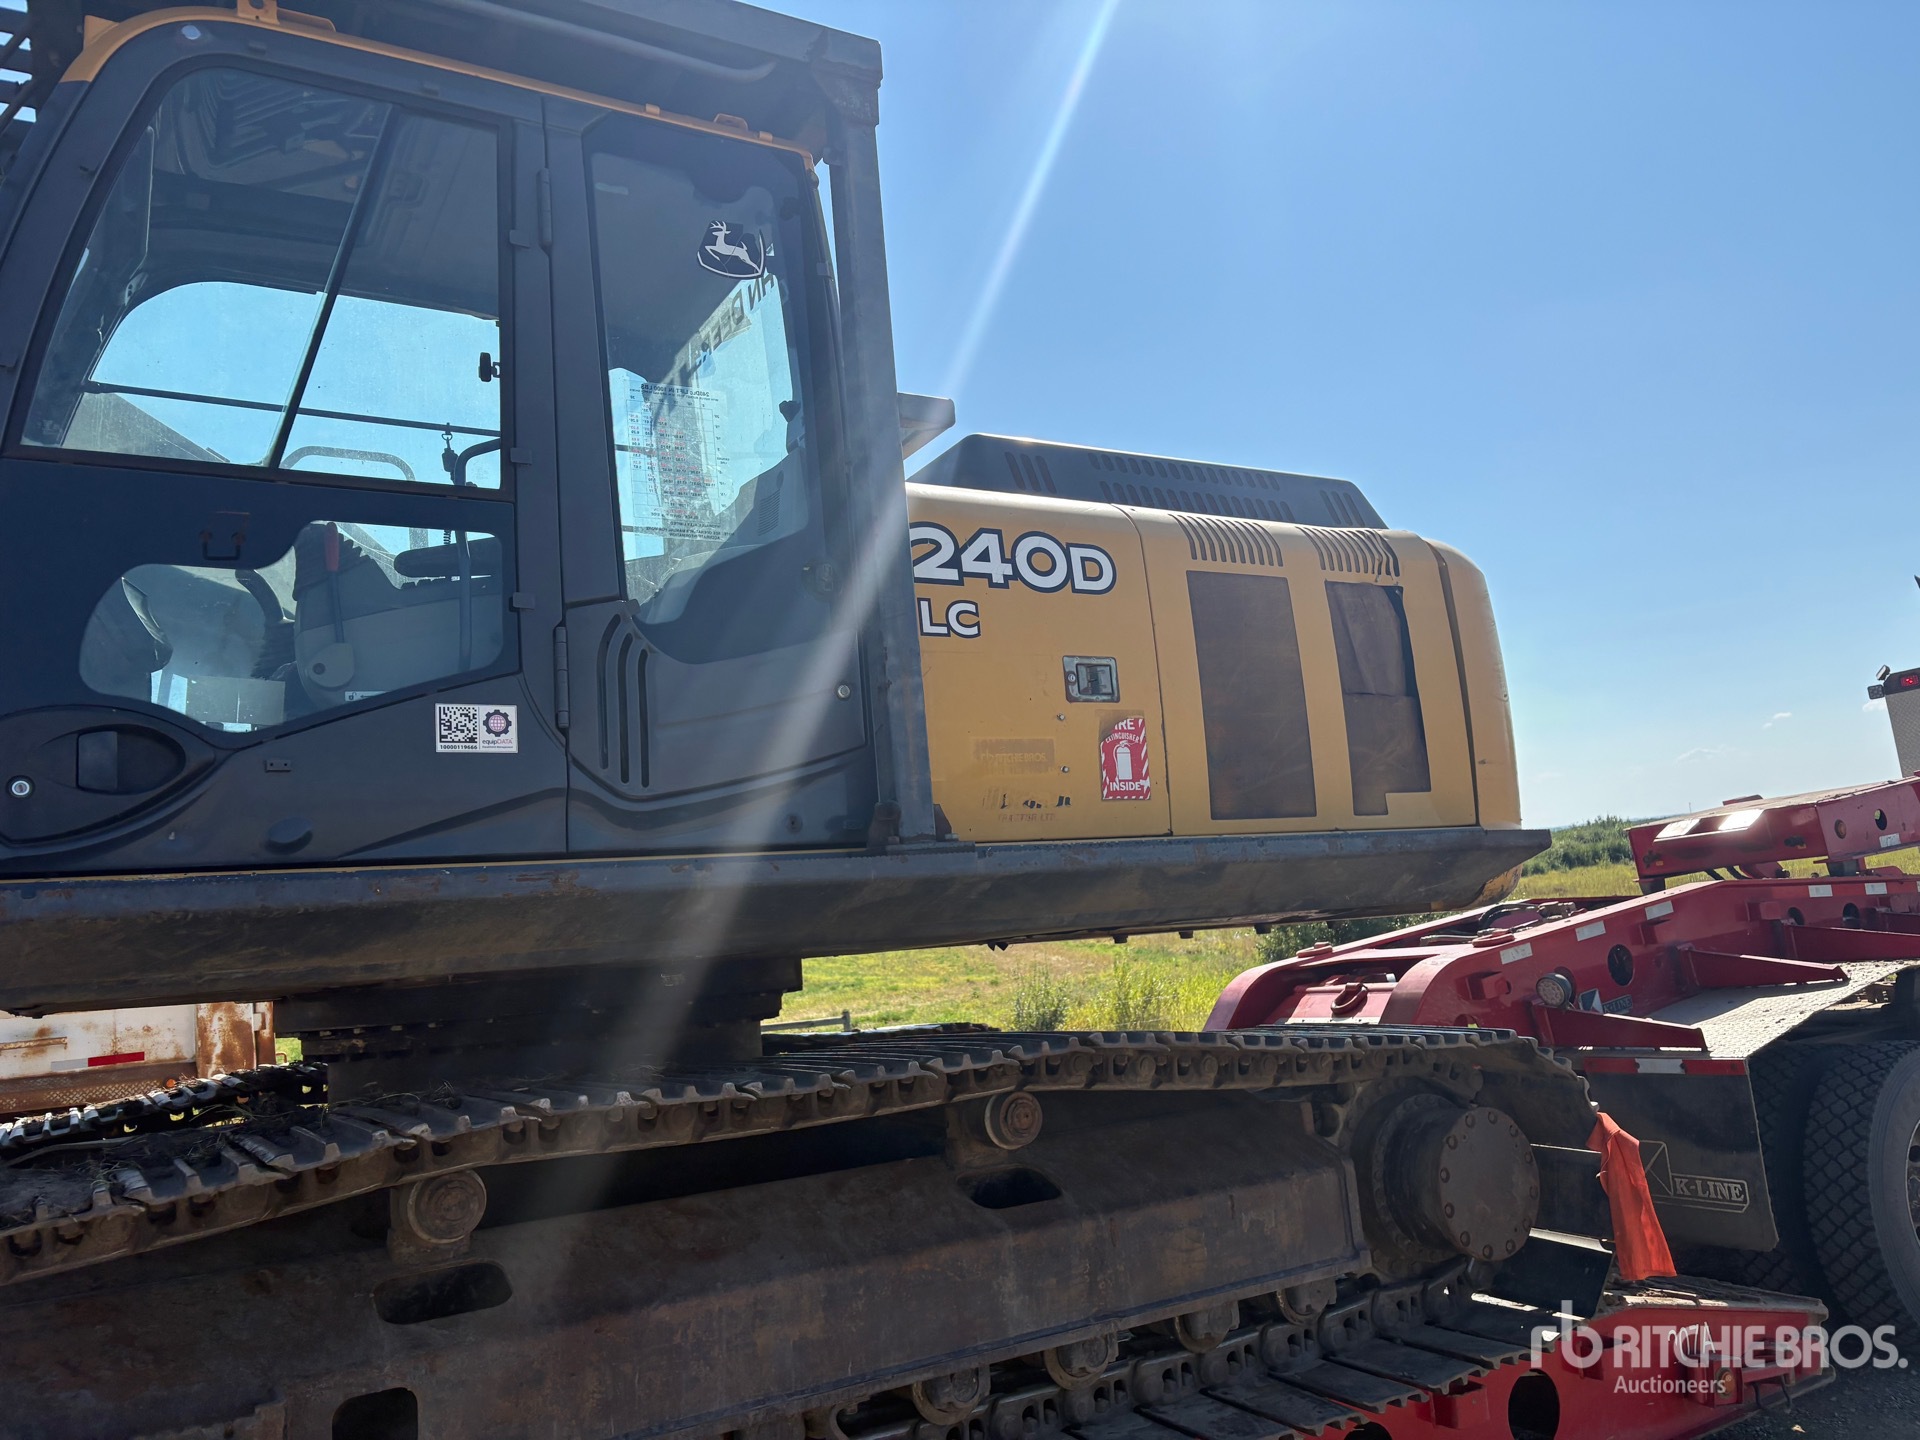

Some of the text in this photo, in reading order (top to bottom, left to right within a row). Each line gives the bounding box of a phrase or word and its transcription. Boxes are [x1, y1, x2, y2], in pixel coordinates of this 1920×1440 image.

[909, 521, 1117, 595] 240D
[917, 598, 981, 638] LC
[1114, 718, 1136, 730] IRE
[1109, 781, 1142, 792] INSIDE
[1674, 1177, 1745, 1201] K-LINE
